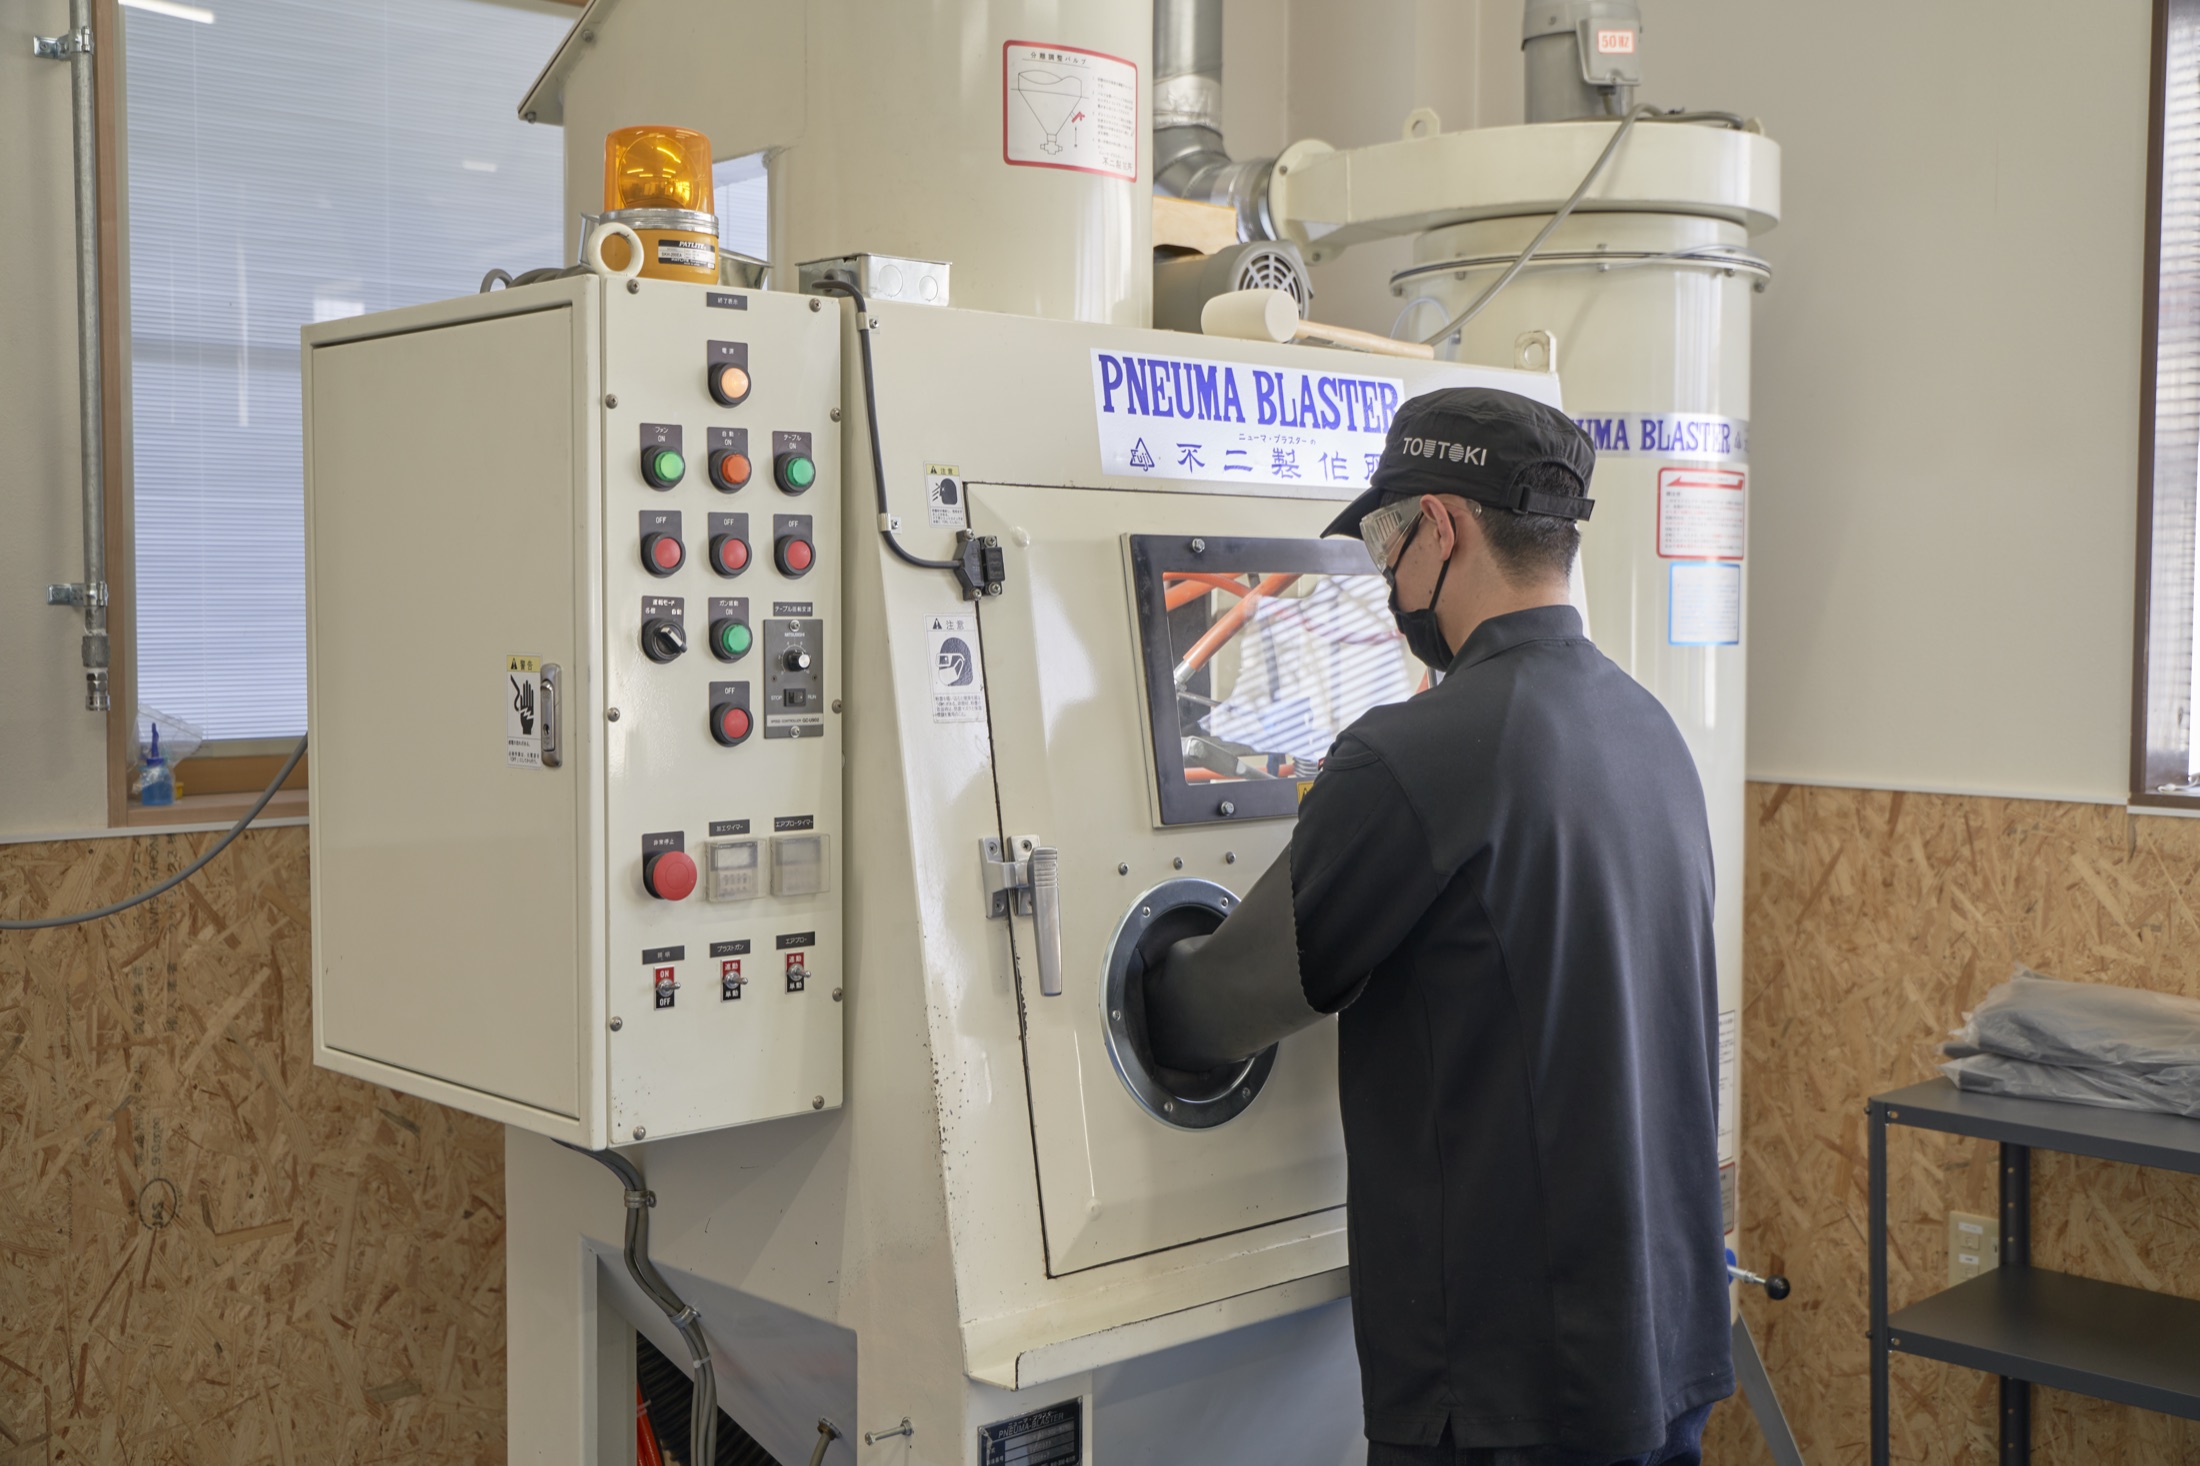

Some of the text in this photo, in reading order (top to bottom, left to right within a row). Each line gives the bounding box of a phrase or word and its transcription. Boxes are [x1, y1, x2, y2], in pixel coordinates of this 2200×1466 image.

[679, 241, 705, 250] PATLITE
[1098, 354, 1399, 434] PNEUMA BLASTER
[657, 435, 666, 443] ON
[1573, 419, 1630, 451] MA
[1640, 420, 1731, 454] BLASTER
[724, 438, 733, 446] ON
[788, 442, 797, 450] ON
[655, 516, 667, 524] OFF
[723, 518, 734, 526] OFF
[788, 520, 799, 528] OFF
[725, 608, 733, 616] ON
[945, 619, 964, 630] 注意
[520, 660, 533, 671] 警告
[724, 687, 736, 695] OFF
[716, 824, 744, 832] 加工タイマー
[660, 969, 670, 978] ON
[659, 997, 671, 1007] OFF
